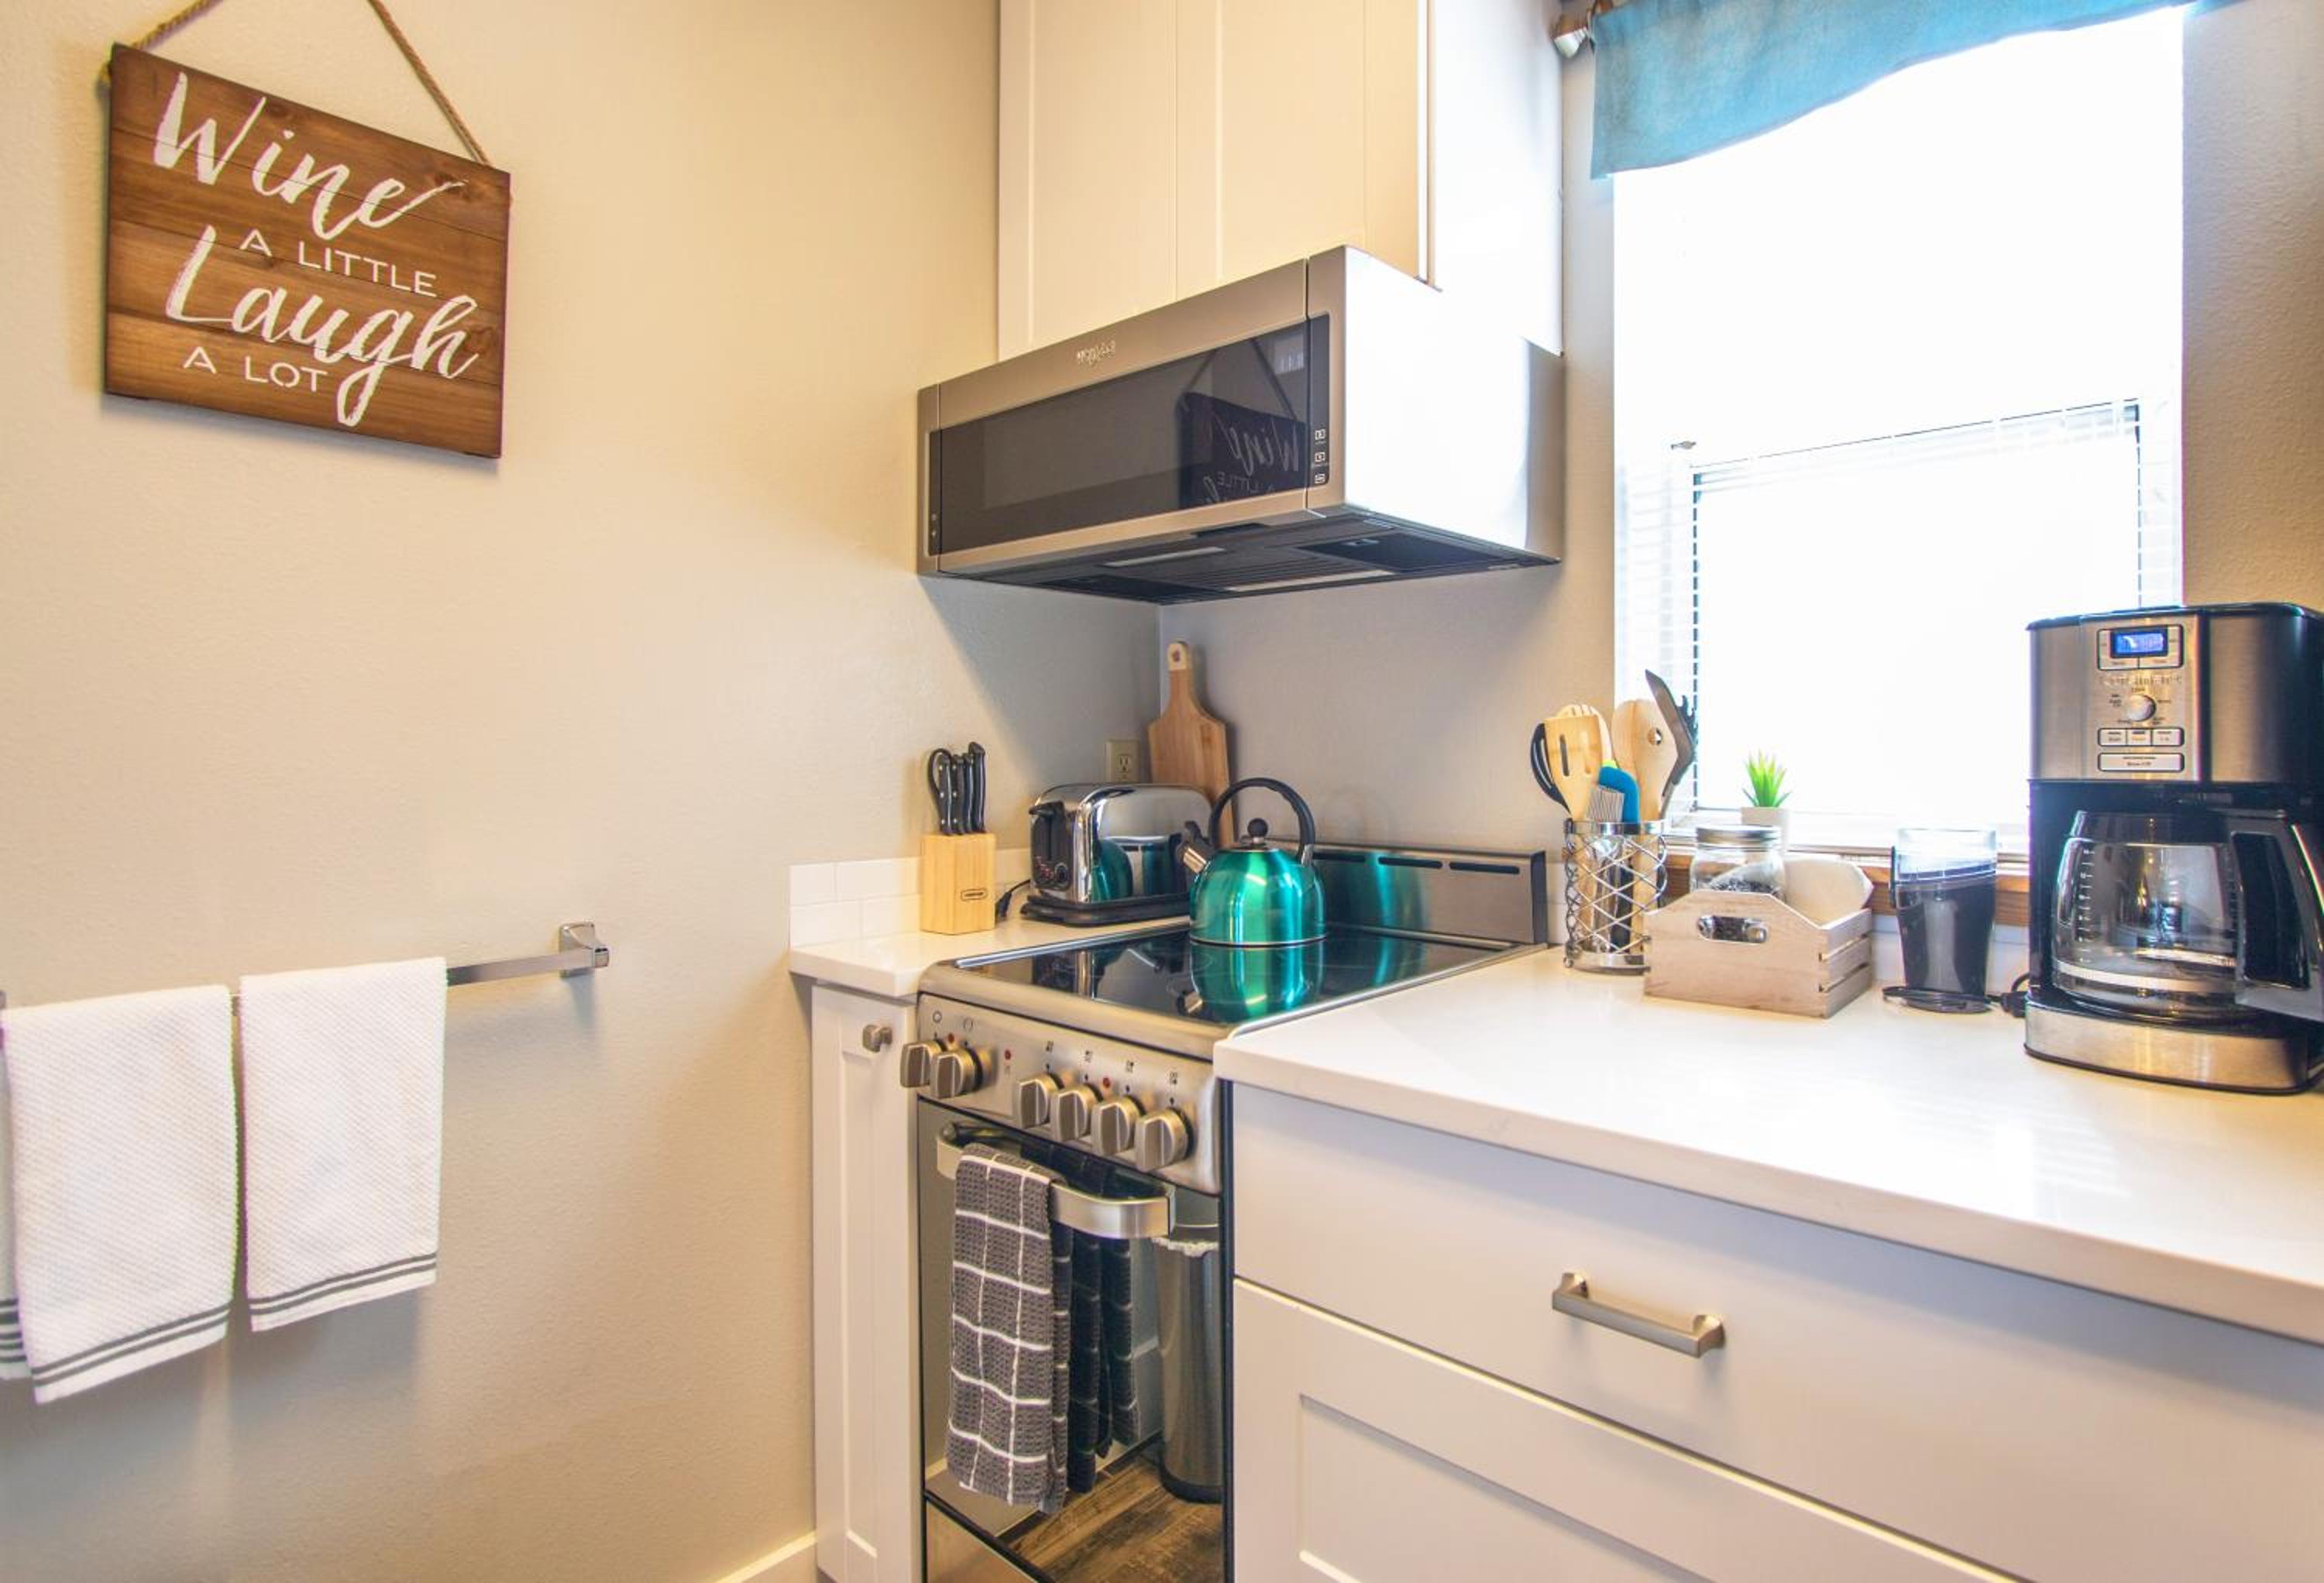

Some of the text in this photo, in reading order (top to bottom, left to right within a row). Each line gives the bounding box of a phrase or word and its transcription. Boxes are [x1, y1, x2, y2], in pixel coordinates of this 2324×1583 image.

[153, 72, 469, 241] Wine
[240, 229, 438, 297] A LITTLE
[167, 225, 479, 426] Laugh
[183, 346, 328, 392] A LOT
